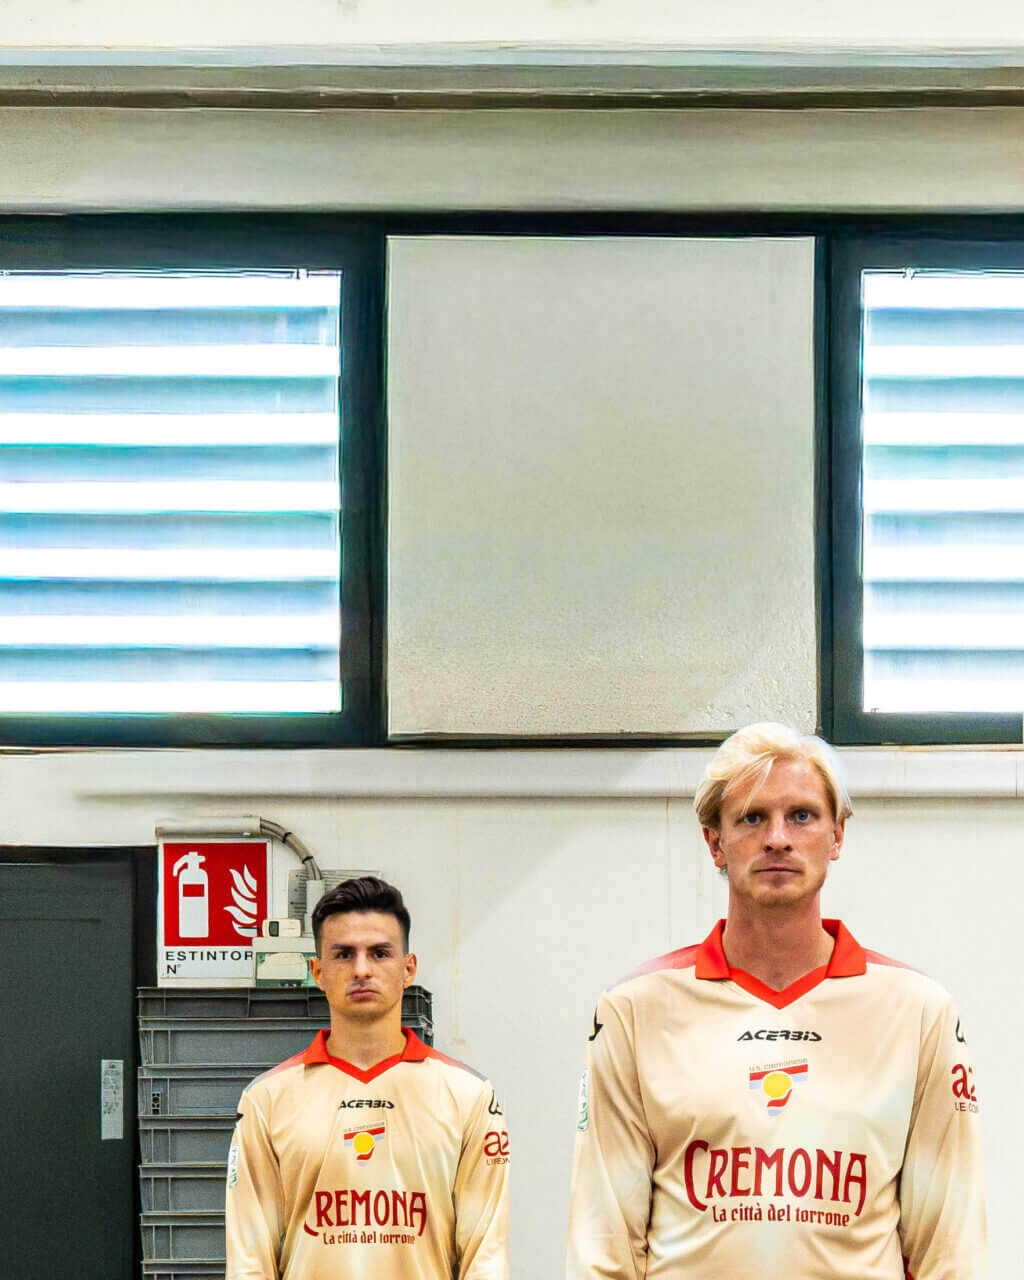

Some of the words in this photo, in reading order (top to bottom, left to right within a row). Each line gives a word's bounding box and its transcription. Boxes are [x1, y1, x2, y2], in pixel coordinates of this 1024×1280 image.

[166, 950, 253, 961] ESTINTOR
[684, 1139, 867, 1217] CREMONA
[712, 1204, 727, 1223] La
[767, 1203, 791, 1222] del
[795, 1207, 850, 1227] torrone
[323, 1232, 335, 1245] La
